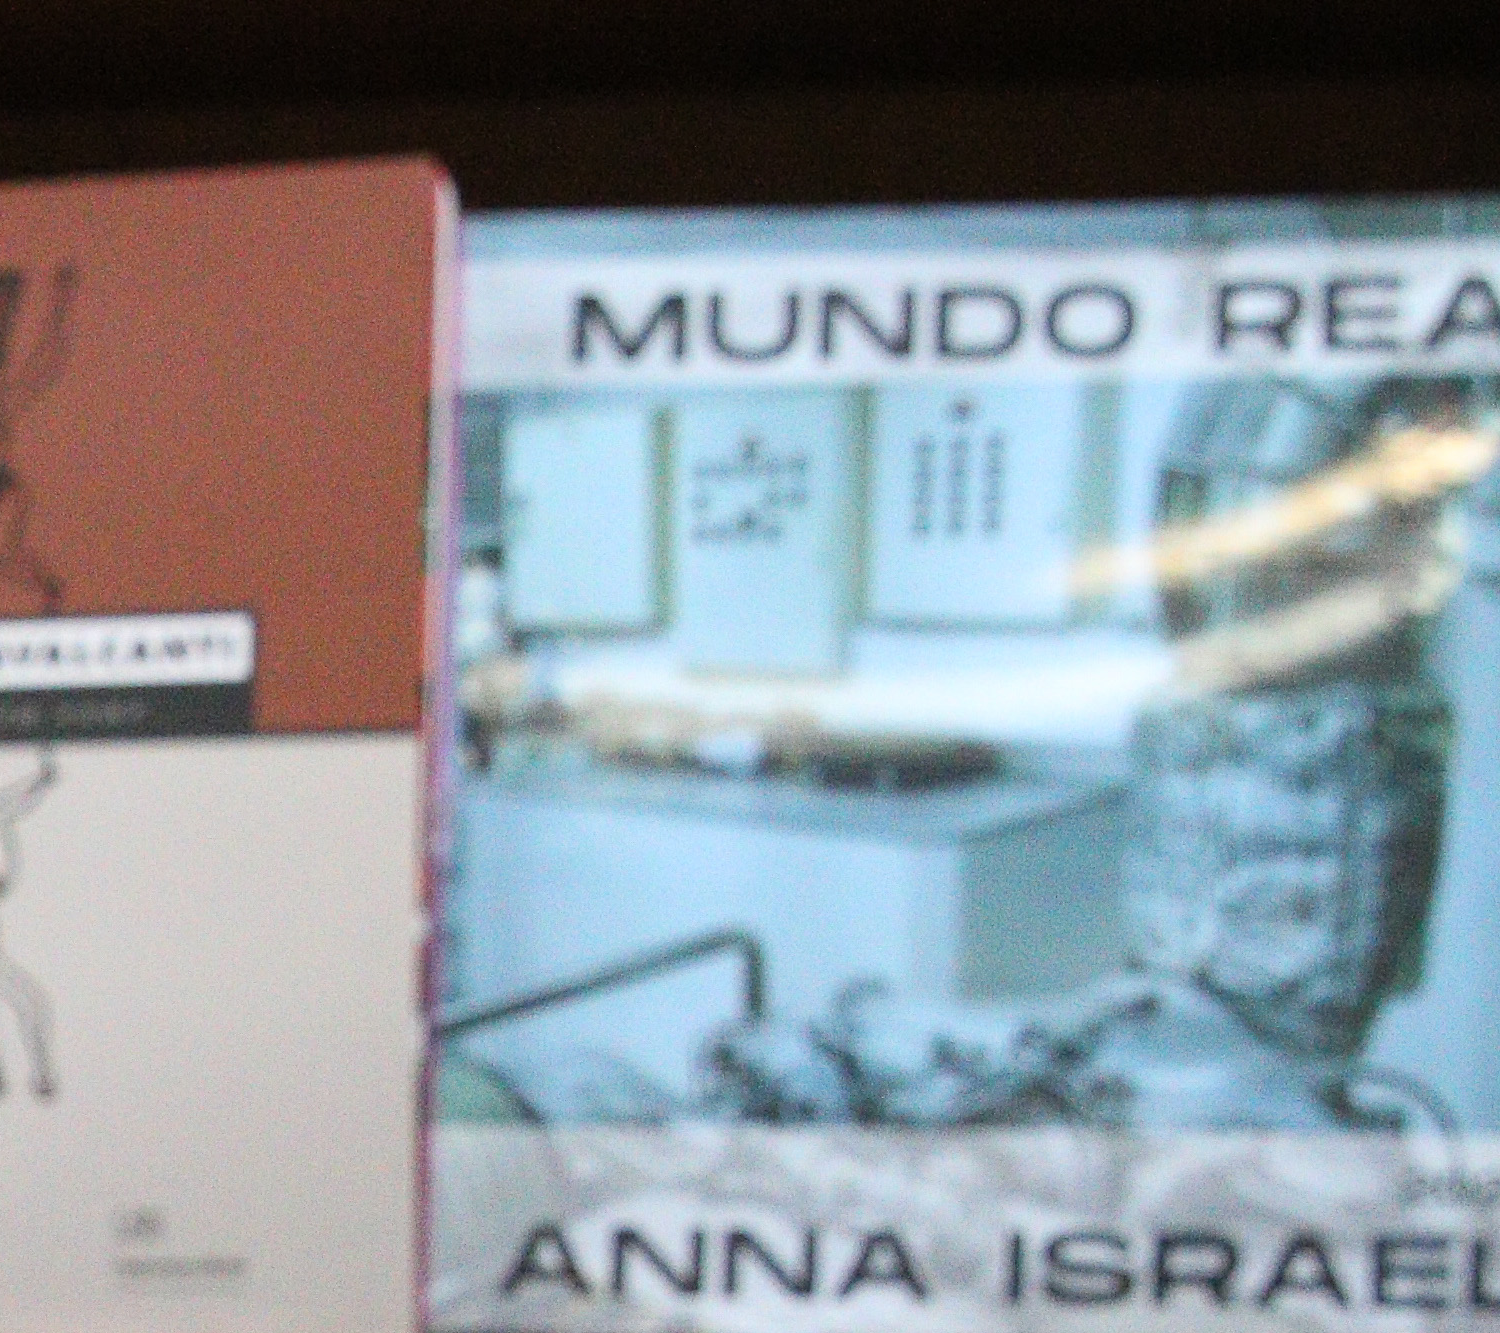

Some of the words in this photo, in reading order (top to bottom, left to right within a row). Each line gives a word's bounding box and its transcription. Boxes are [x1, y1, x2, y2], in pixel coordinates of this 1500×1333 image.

[567, 280, 1138, 368] MUNDO
[1209, 273, 1500, 356] REA
[500, 1221, 927, 1303] ANNA
[1005, 1226, 1500, 1307] ISRAEL
